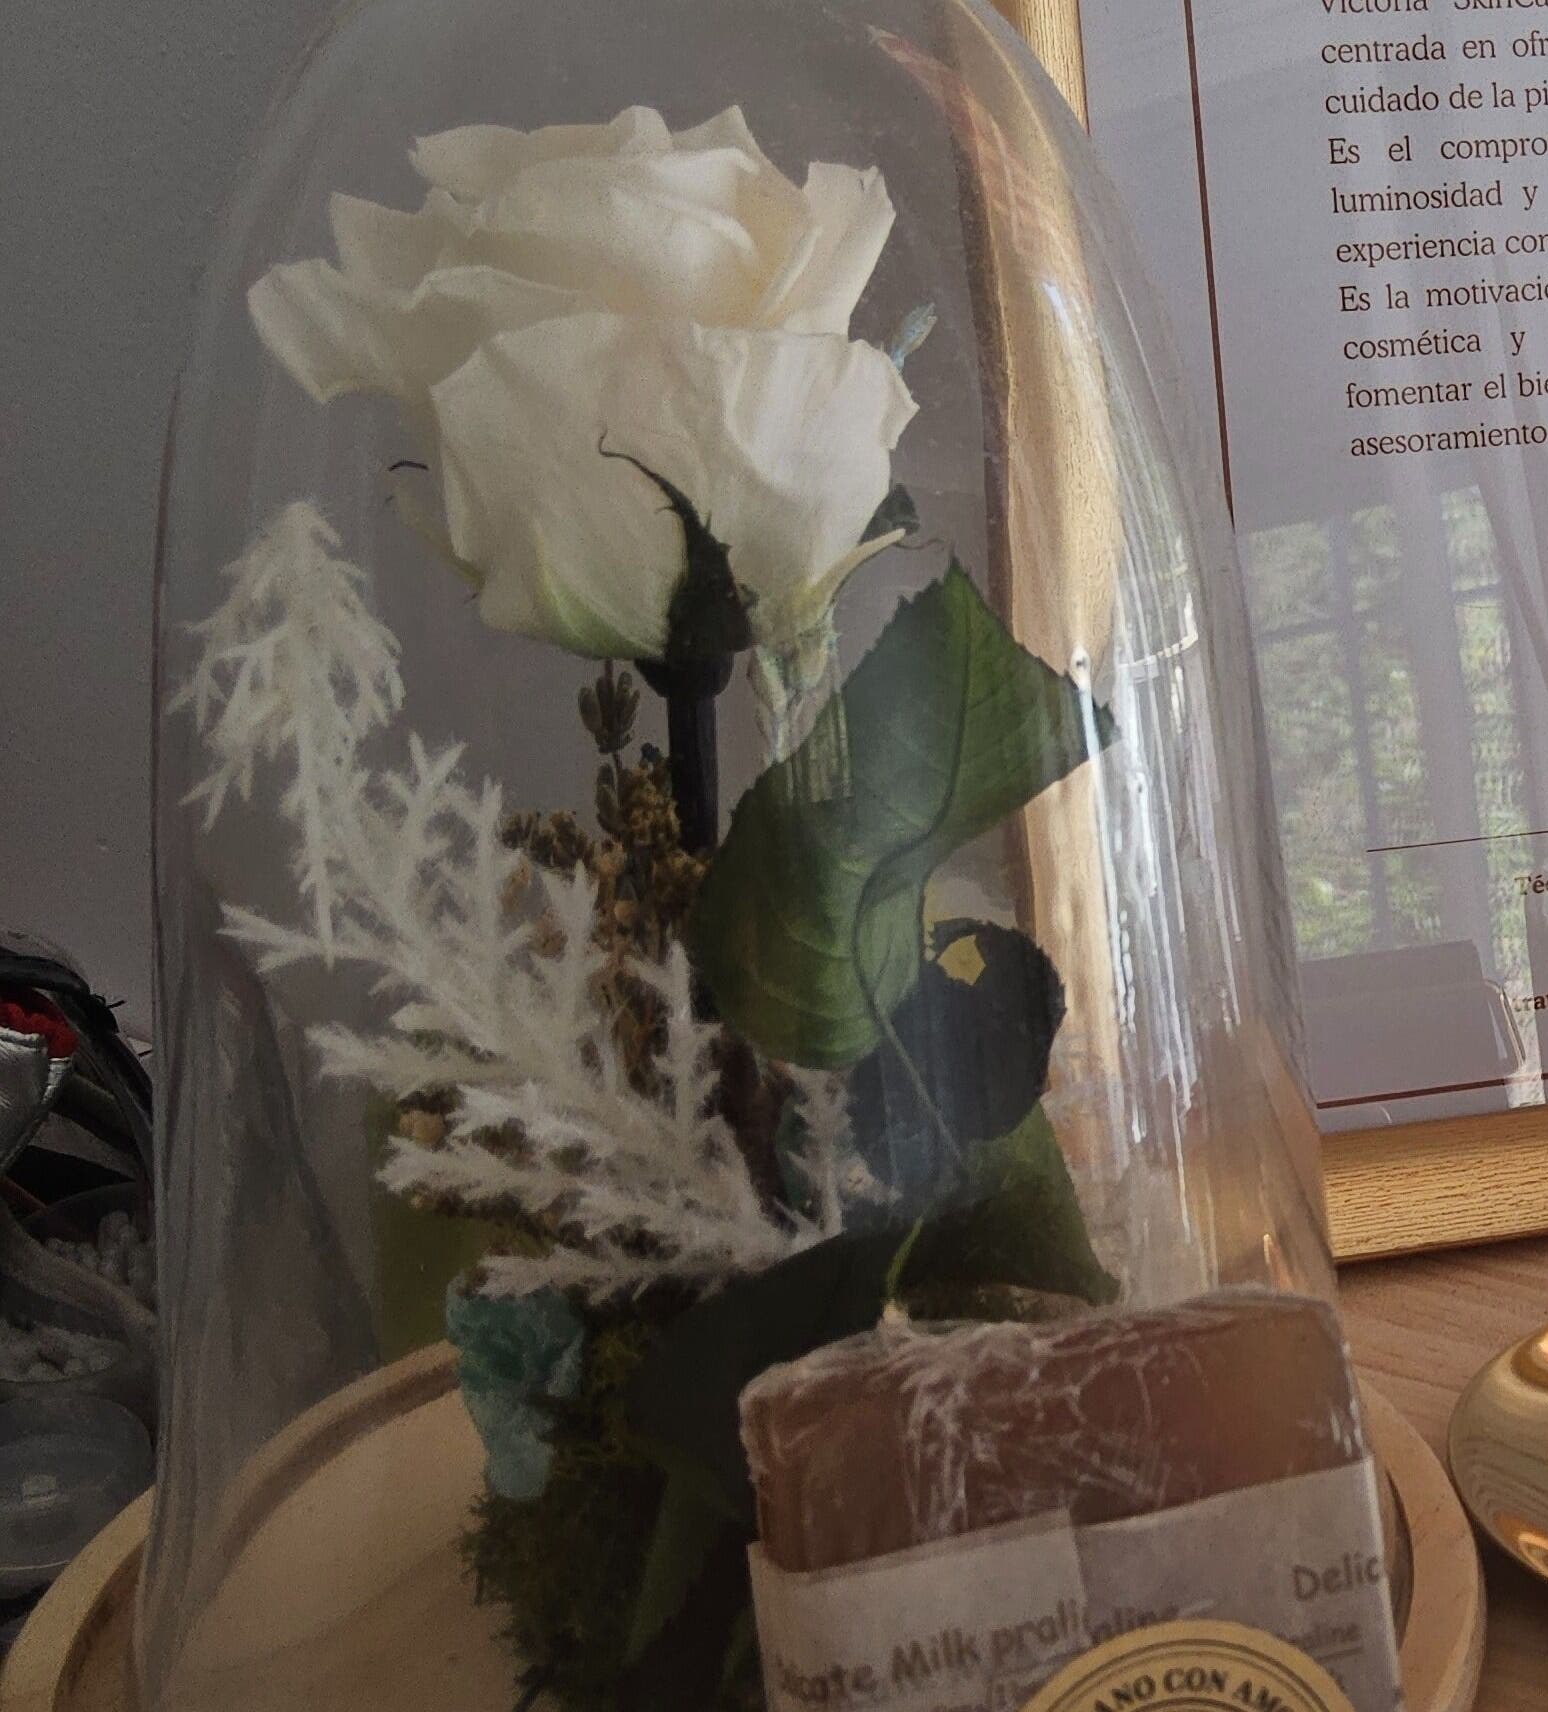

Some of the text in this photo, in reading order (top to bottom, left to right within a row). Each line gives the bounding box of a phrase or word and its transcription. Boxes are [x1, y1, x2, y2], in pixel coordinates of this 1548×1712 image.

[1322, 34, 1446, 63] centrada
[1463, 40, 1496, 59] en
[1326, 85, 1439, 114] cuidado
[1449, 83, 1482, 109] de
[1492, 82, 1515, 107] la
[1328, 138, 1360, 164] Es
[1389, 136, 1411, 161] el
[1332, 180, 1502, 213] luminosidad
[1523, 186, 1537, 210] y
[1337, 231, 1495, 267] experiencia
[1340, 286, 1370, 311] Es
[1386, 284, 1409, 309] la
[1344, 329, 1481, 359] cosmética
[1510, 332, 1525, 356] y
[1346, 383, 1472, 408] fomentar
[1484, 374, 1506, 399] el
[1351, 423, 1547, 456] asesoramiento
[892, 1626, 981, 1687] Milk
[1162, 1667, 1230, 1694] CON
